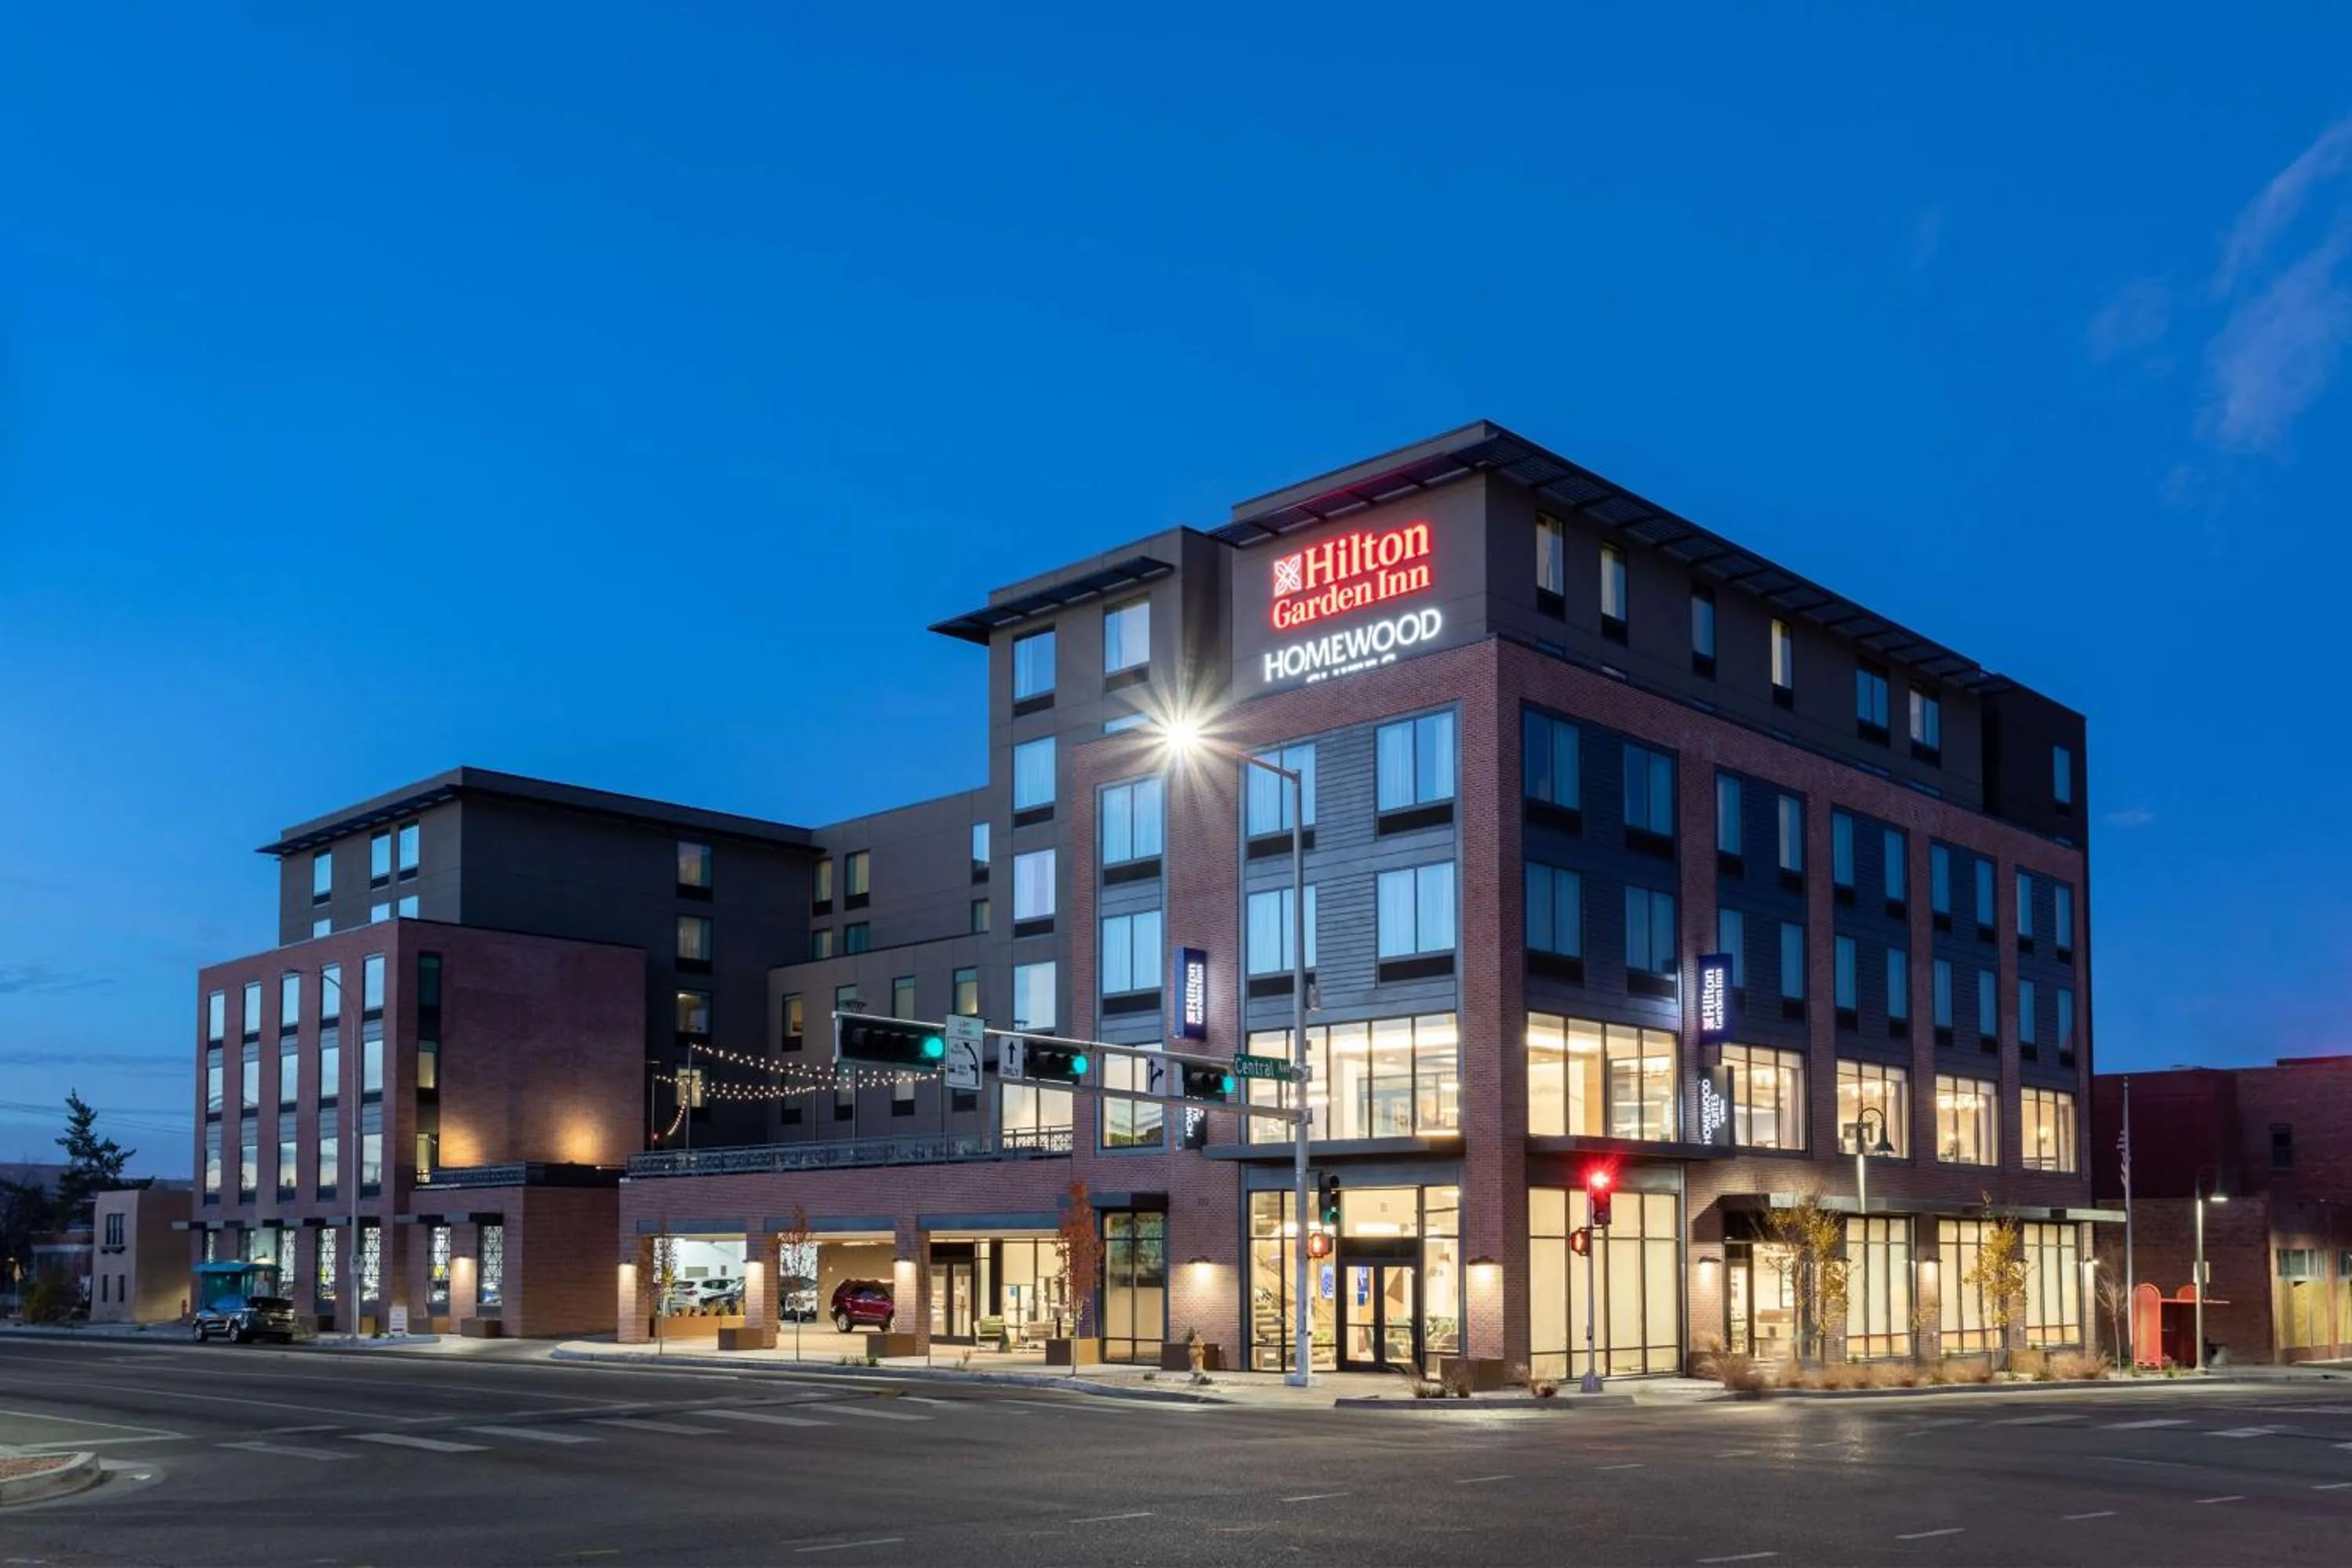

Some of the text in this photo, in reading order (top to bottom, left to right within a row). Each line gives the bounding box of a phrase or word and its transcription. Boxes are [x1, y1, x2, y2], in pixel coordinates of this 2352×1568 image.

[1305, 524, 1430, 590] Hilton
[1272, 564, 1431, 629] Garden Inn
[1263, 608, 1443, 683] HOMEWOOD
[1703, 968, 1715, 1017] Hilton
[1235, 1057, 1275, 1077] Central
[1701, 1079, 1712, 1145] HOMEWOOD
[1710, 1093, 1720, 1129] SUITES
